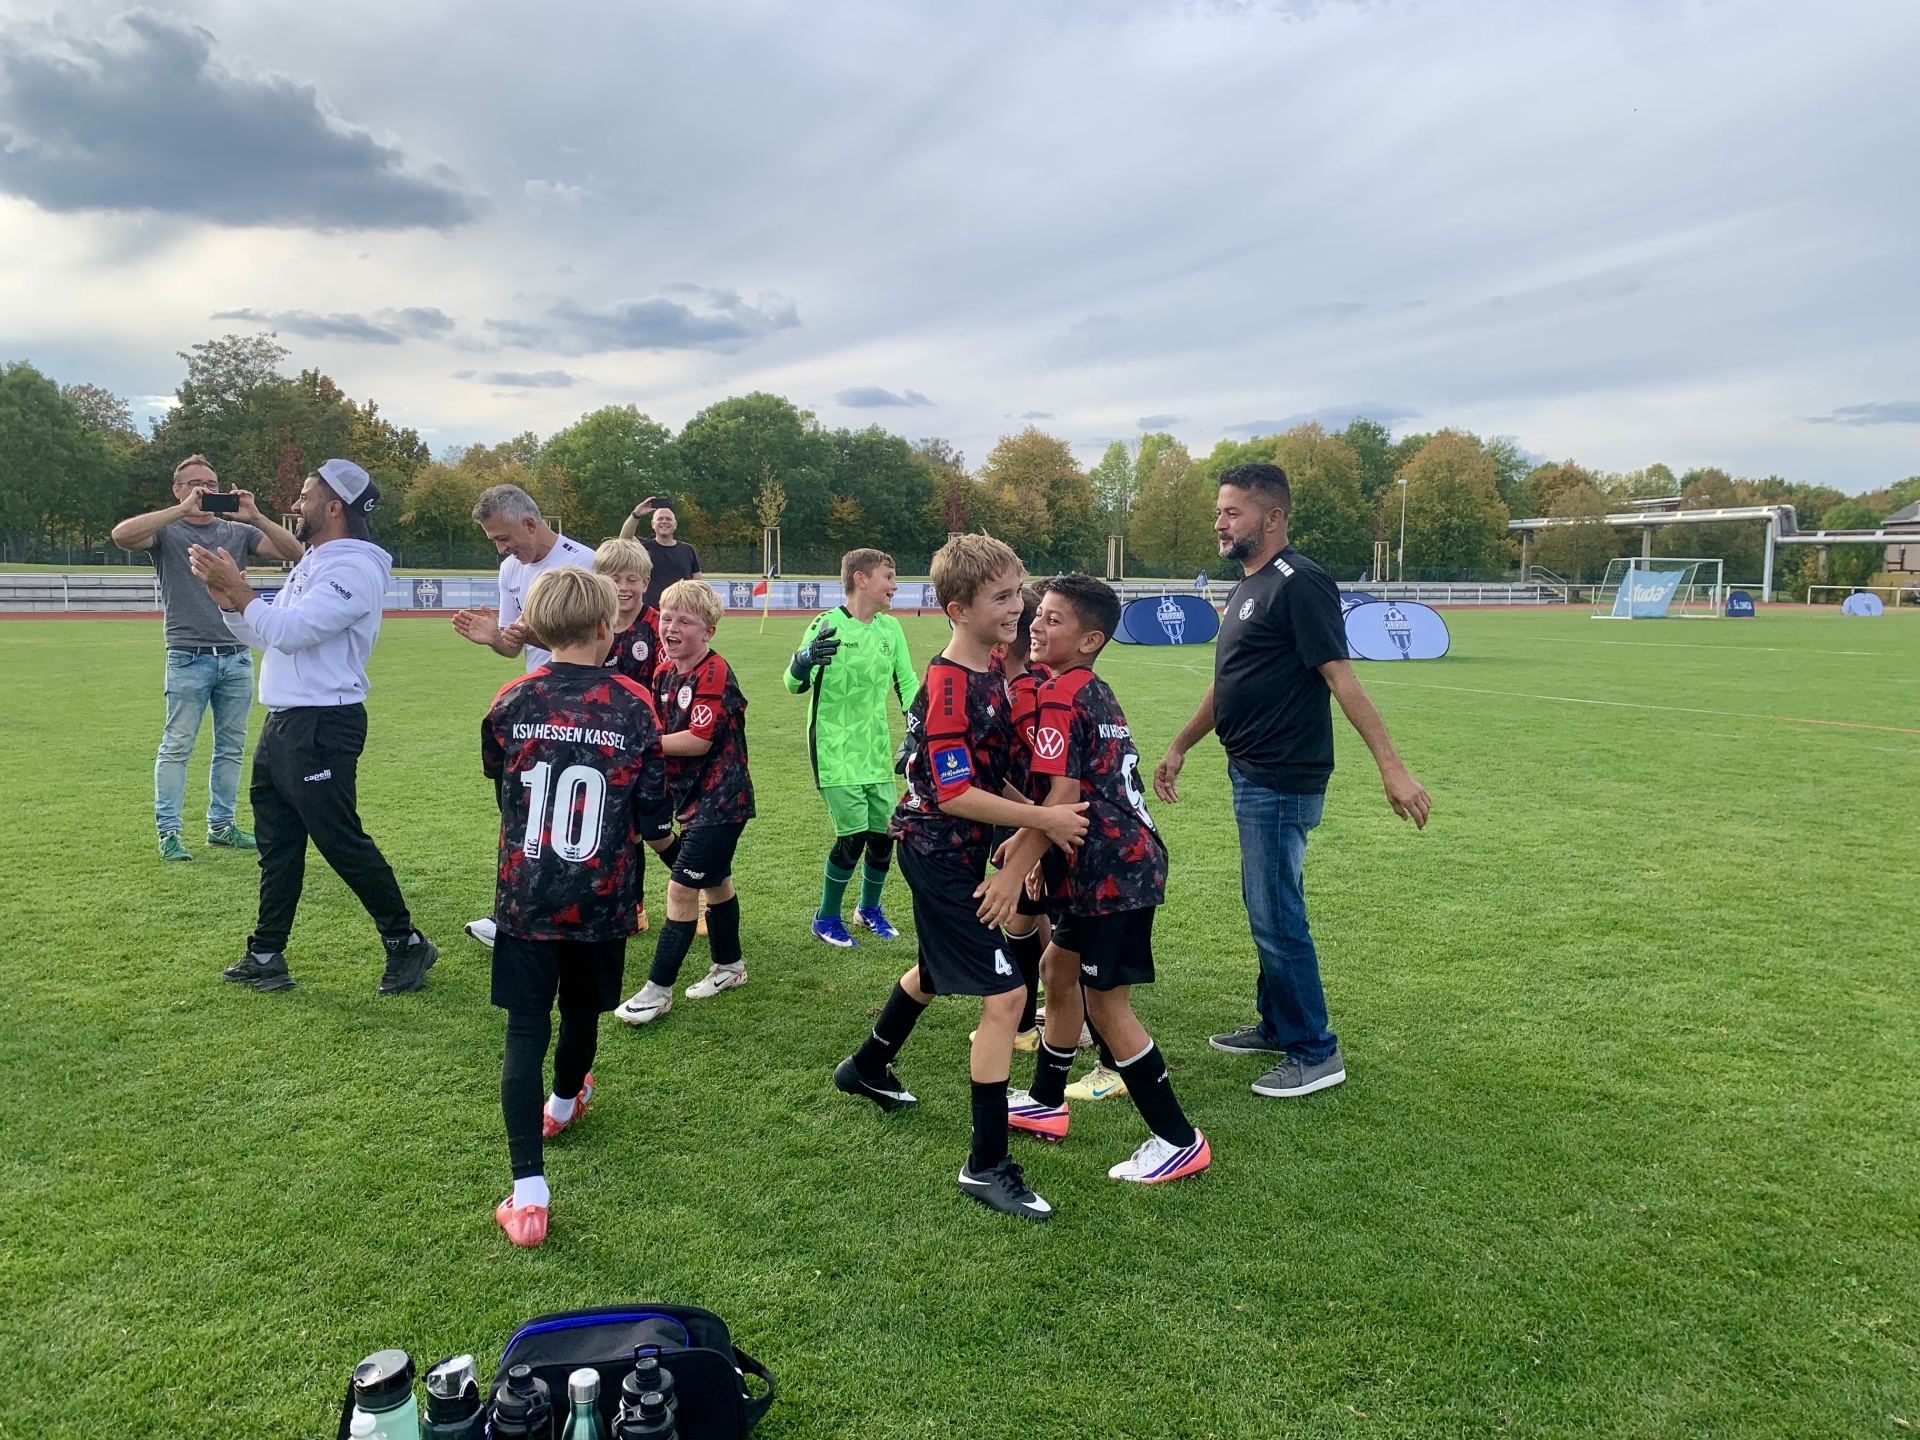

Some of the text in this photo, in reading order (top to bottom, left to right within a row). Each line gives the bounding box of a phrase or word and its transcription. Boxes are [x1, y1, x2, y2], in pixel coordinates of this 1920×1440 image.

[330, 581, 353, 600] capelli
[1383, 620, 1412, 630] CHAIRMAN
[512, 723, 627, 751] KSV HESSEN KASSEL
[303, 769, 332, 782] capelli
[520, 761, 607, 862] 10
[994, 948, 1013, 976] 4
